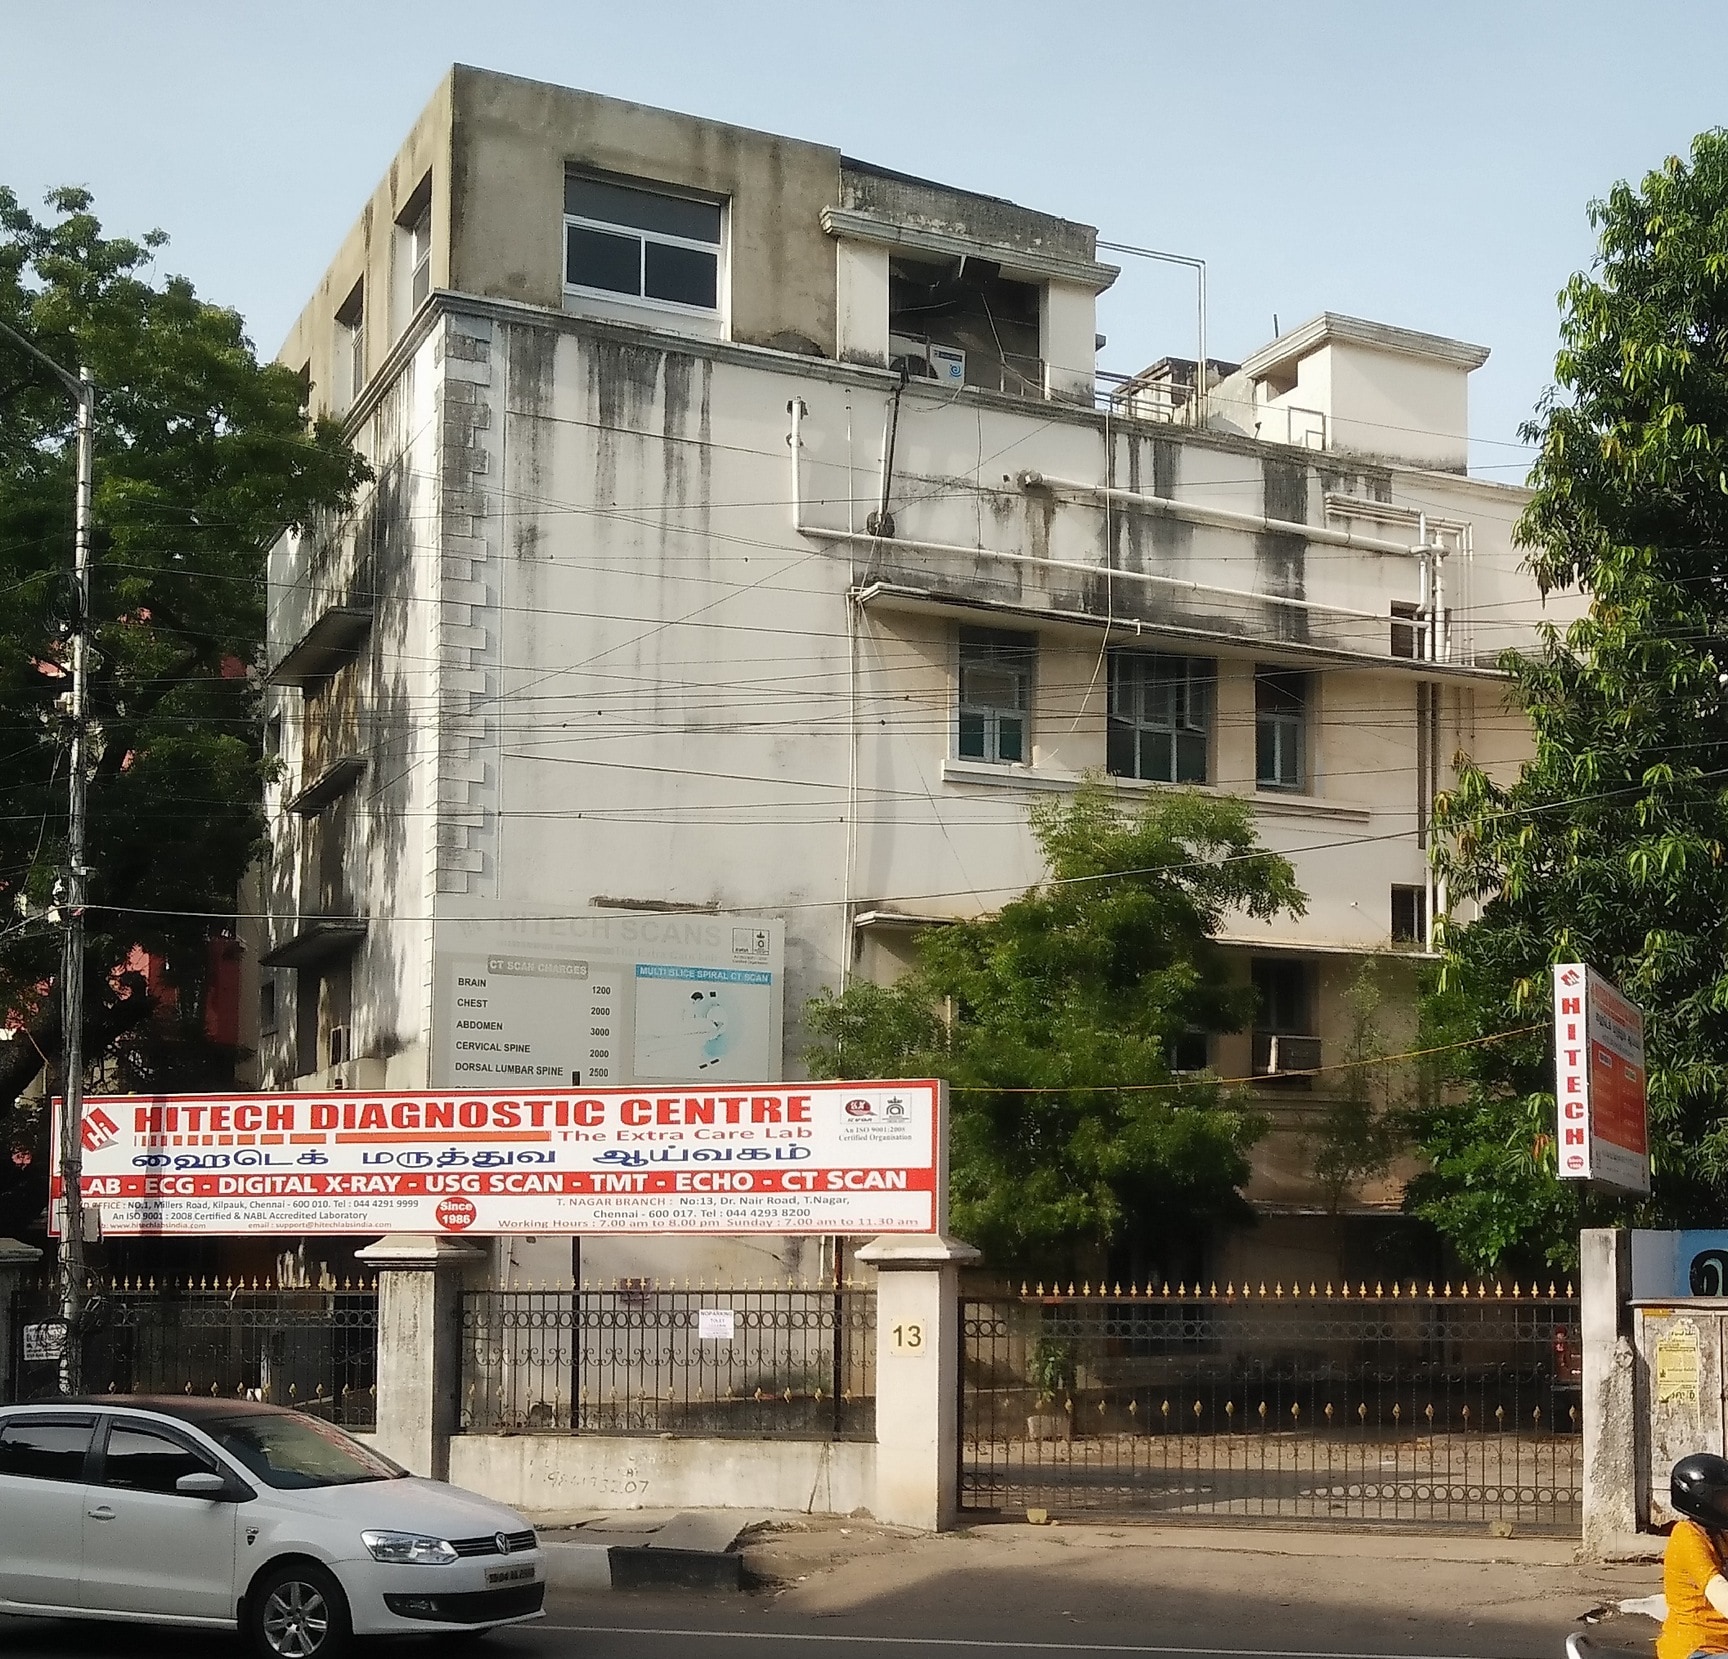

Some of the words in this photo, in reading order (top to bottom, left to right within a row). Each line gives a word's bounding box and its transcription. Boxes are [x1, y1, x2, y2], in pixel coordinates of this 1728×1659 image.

[621, 919, 722, 947] SCANS
[490, 960, 504, 970] CT
[507, 961, 536, 973] SCAN
[538, 963, 587, 976] CHARGES
[639, 966, 668, 976] MULTI
[669, 968, 695, 978] SLICE
[696, 970, 728, 981] SPIRAL
[730, 972, 742, 981] CT
[744, 973, 769, 983] SCAN
[458, 977, 487, 987] BRAIN
[592, 985, 611, 995] 1200
[457, 998, 488, 1008] CHEST
[590, 1007, 611, 1016] 2000
[456, 1020, 503, 1030] ABDOMEN
[590, 1027, 610, 1036] 3000
[456, 1041, 501, 1051] CERVICAL
[503, 1043, 531, 1053] SPINE
[589, 1049, 610, 1058] 2000
[455, 1062, 493, 1072] DORSAL
[495, 1064, 534, 1075] LUMBAR
[536, 1066, 564, 1076] SPINE
[589, 1068, 609, 1077] 2500
[1561, 997, 1584, 1145] HITECH
[134, 1104, 295, 1133] HITECH
[310, 1099, 605, 1130] DIAGNOSTIC
[620, 1095, 812, 1126] CENTRE
[557, 1130, 607, 1142] The
[616, 1130, 684, 1142] Extra
[693, 1128, 755, 1140] Care
[765, 1127, 813, 1139] Lab
[869, 1133, 912, 1142] Organisation
[131, 1148, 329, 1171] ஹைடெக்
[362, 1147, 556, 1168] மருத்துவ
[592, 1143, 812, 1167] ஆய்வகம்
[144, 1177, 195, 1194] ECG
[218, 1176, 318, 1194] DIGITAL
[324, 1175, 402, 1193] X-RAY
[425, 1174, 480, 1192] USG
[489, 1174, 563, 1192] SCAN
[589, 1173, 649, 1192] TMT
[675, 1172, 754, 1192] ECHO
[781, 1171, 818, 1190] CT
[826, 1170, 907, 1190] SCAN
[127, 1201, 152, 1210] NO.1,
[153, 1200, 183, 1209] Millers
[186, 1201, 211, 1210] Road,
[212, 1200, 247, 1211] Kilpauk,
[249, 1200, 285, 1209] Chennai
[292, 1200, 310, 1209] 600
[312, 1200, 331, 1209] 010.
[333, 1200, 346, 1208] Tel
[353, 1199, 370, 1208] 044
[371, 1199, 394, 1208] 4291
[396, 1199, 419, 1208] 9999
[439, 1201, 473, 1212] Since
[556, 1198, 565, 1206] T.
[569, 1198, 612, 1206] NAGAR
[615, 1197, 666, 1206] BRANCH
[680, 1197, 717, 1207] No:13,
[720, 1197, 736, 1205] Dr.
[739, 1196, 764, 1205] Nair
[766, 1196, 800, 1206] Road,
[803, 1195, 850, 1207] T.Nagar,
[112, 1212, 124, 1220] An
[126, 1212, 140, 1220] ISO
[143, 1212, 163, 1220] 9001
[171, 1212, 193, 1220] 2008
[194, 1211, 232, 1220] Certified
[234, 1212, 241, 1220] &
[243, 1211, 267, 1220] NABL
[268, 1211, 317, 1219] Accredited
[319, 1211, 368, 1221] Laboratory
[593, 1209, 639, 1218] Chennai
[648, 1209, 670, 1218] 600
[672, 1209, 697, 1218] 017.
[700, 1209, 717, 1218] Tel
[726, 1209, 749, 1218] 044
[750, 1209, 778, 1218] 4293
[781, 1208, 811, 1217] 8200
[441, 1214, 471, 1225] 1986
[498, 1219, 549, 1228] Working
[553, 1219, 589, 1227] Hours
[599, 1219, 626, 1227] 7.00
[652, 1219, 665, 1227] to
[668, 1219, 696, 1227] 8.00
[699, 1220, 720, 1228] pm
[727, 1218, 774, 1228] Sunday
[784, 1218, 813, 1226] 7.00
[840, 1218, 854, 1226] to
[857, 1217, 894, 1226] 11.30
[892, 1324, 922, 1347] 13
